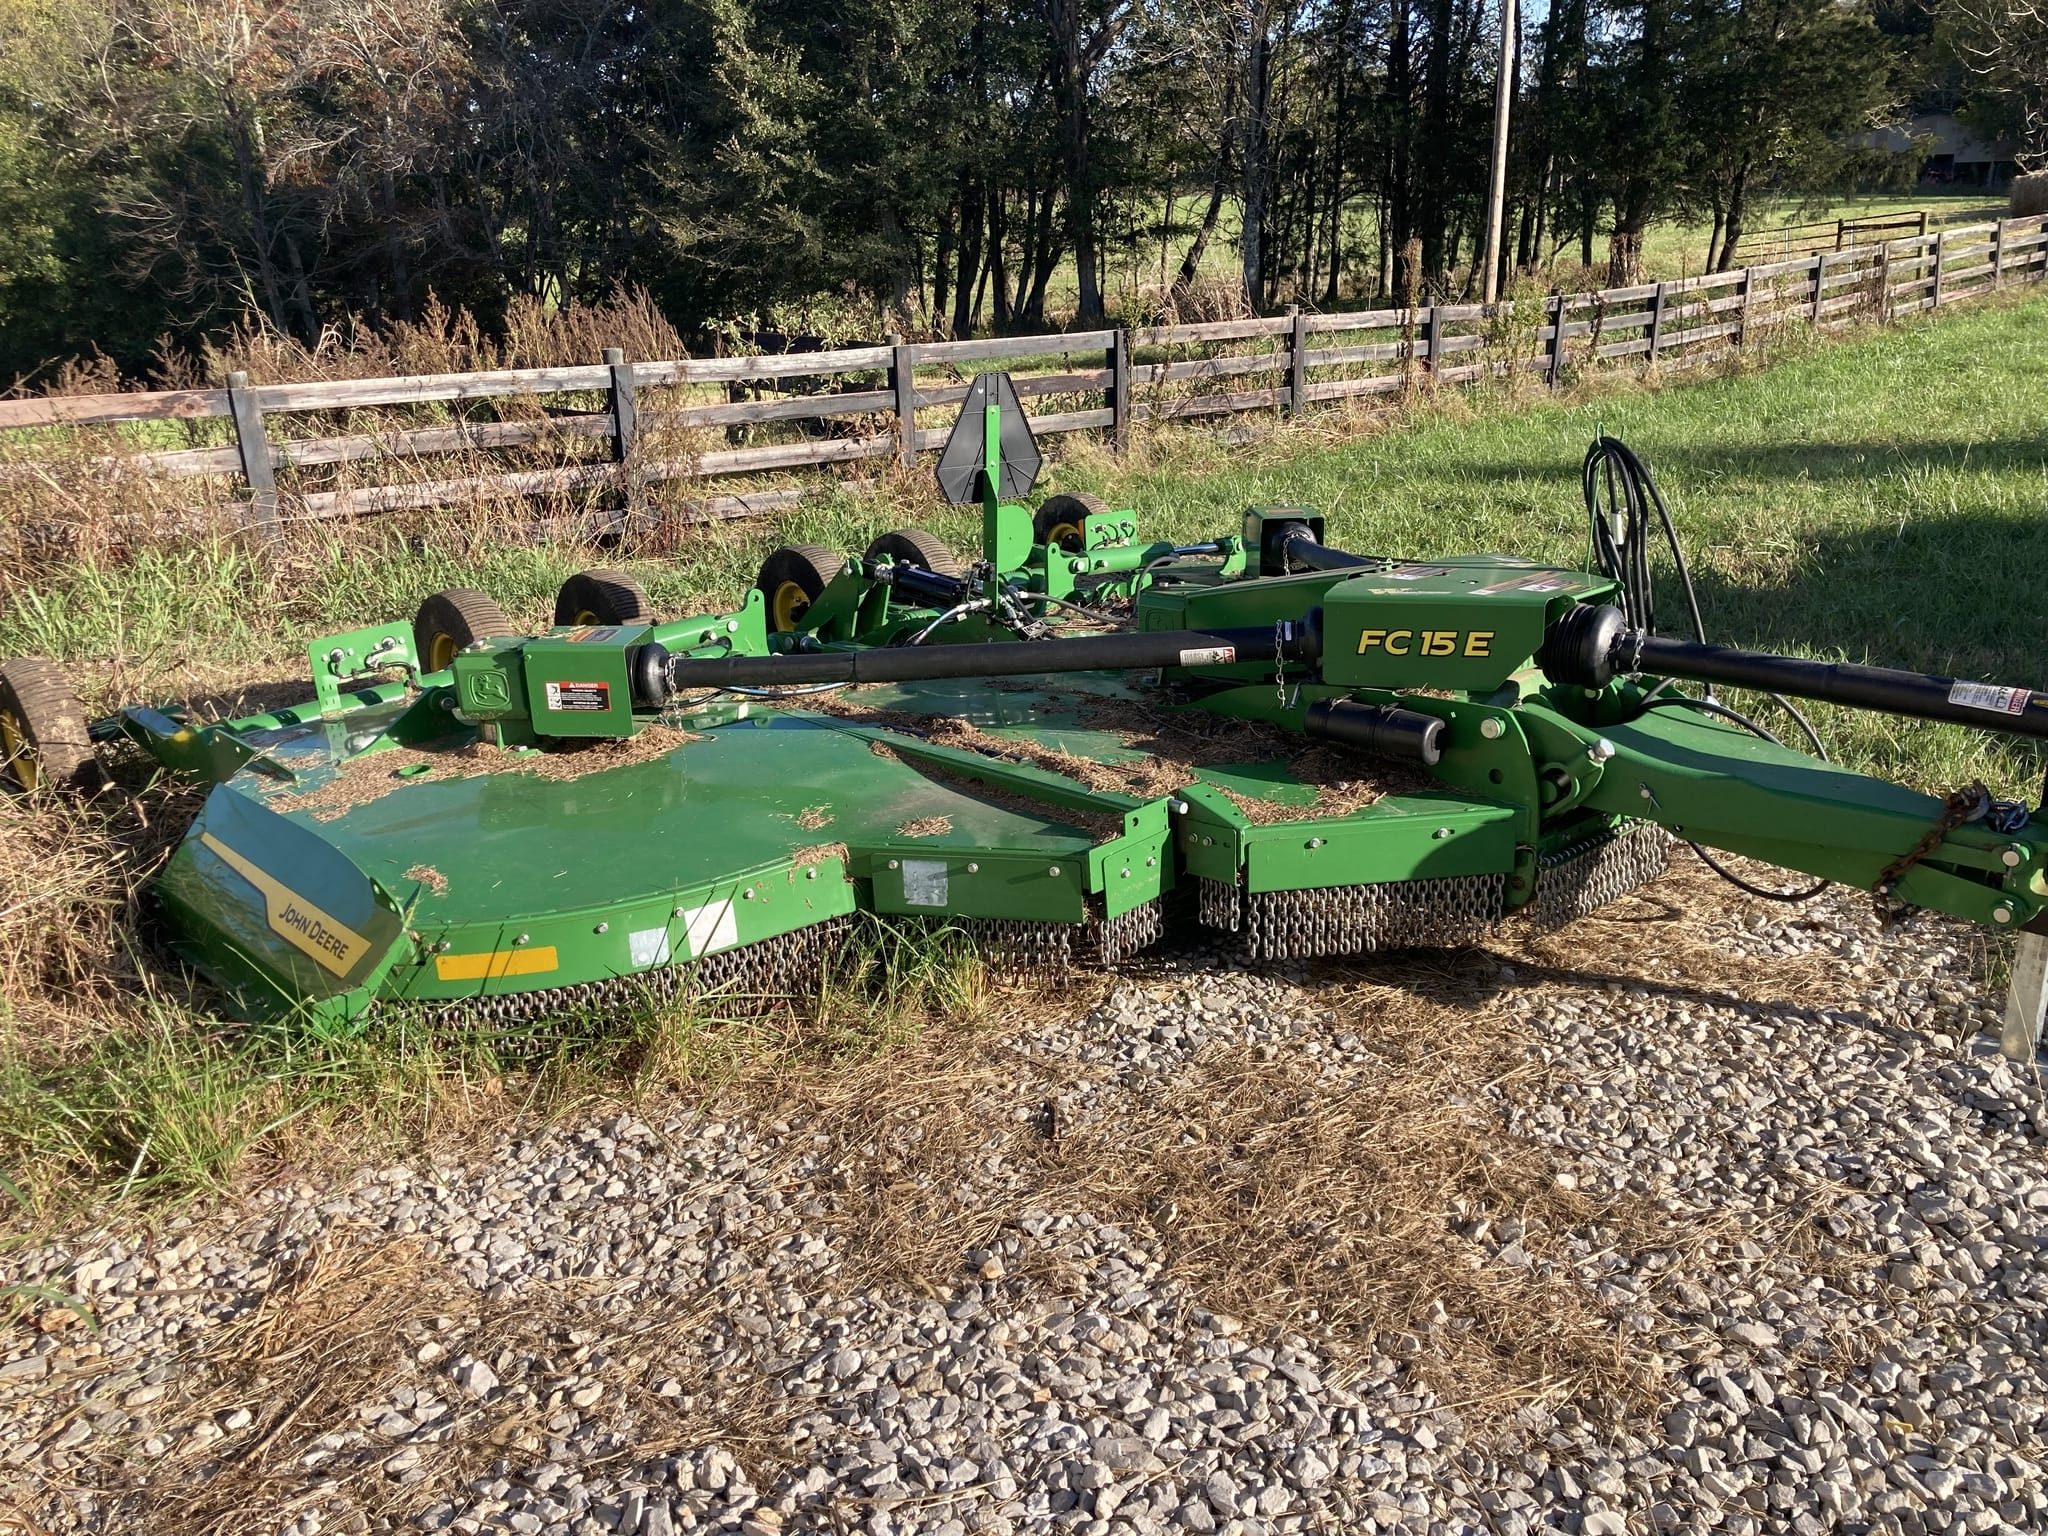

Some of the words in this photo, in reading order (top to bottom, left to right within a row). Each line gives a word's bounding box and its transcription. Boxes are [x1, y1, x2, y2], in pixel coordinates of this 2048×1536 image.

[1357, 629, 1413, 655] FC
[1420, 631, 1458, 656] 15
[1462, 631, 1495, 657] E
[278, 903, 312, 935] JOHN
[308, 921, 349, 961] DEERE
